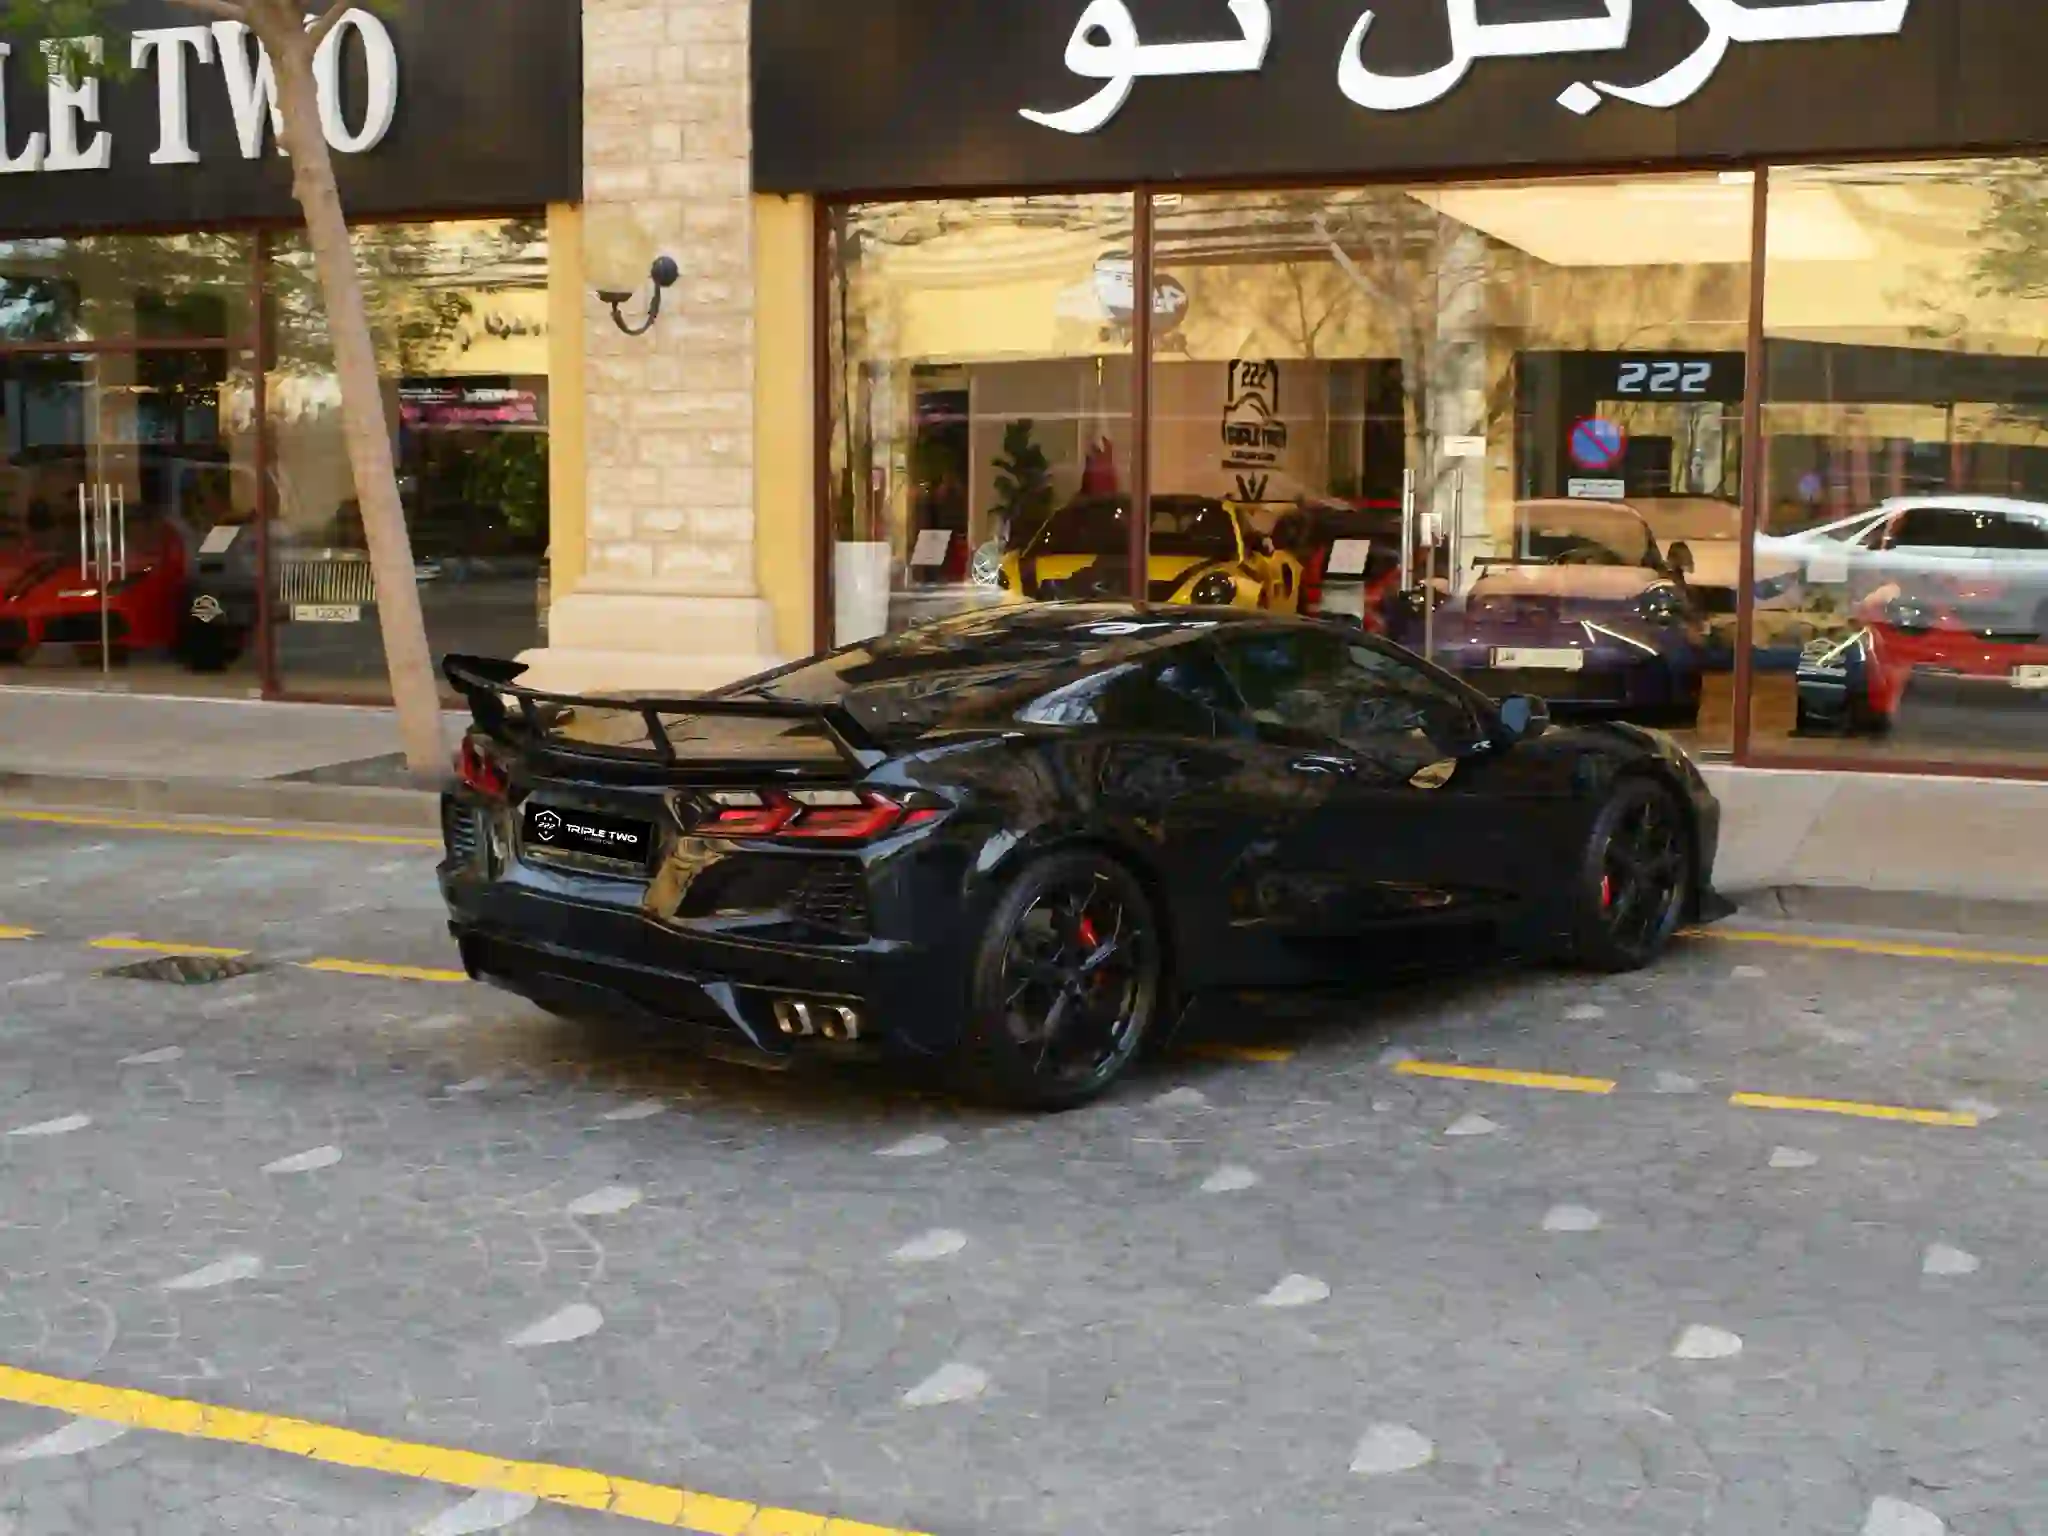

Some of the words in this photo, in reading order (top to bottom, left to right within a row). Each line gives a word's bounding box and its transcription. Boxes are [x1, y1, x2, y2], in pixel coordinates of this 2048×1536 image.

[131, 8, 398, 164] TWO
[1617, 362, 1711, 392] 222
[566, 824, 606, 838] TRIPLE
[609, 832, 638, 843] TWO
